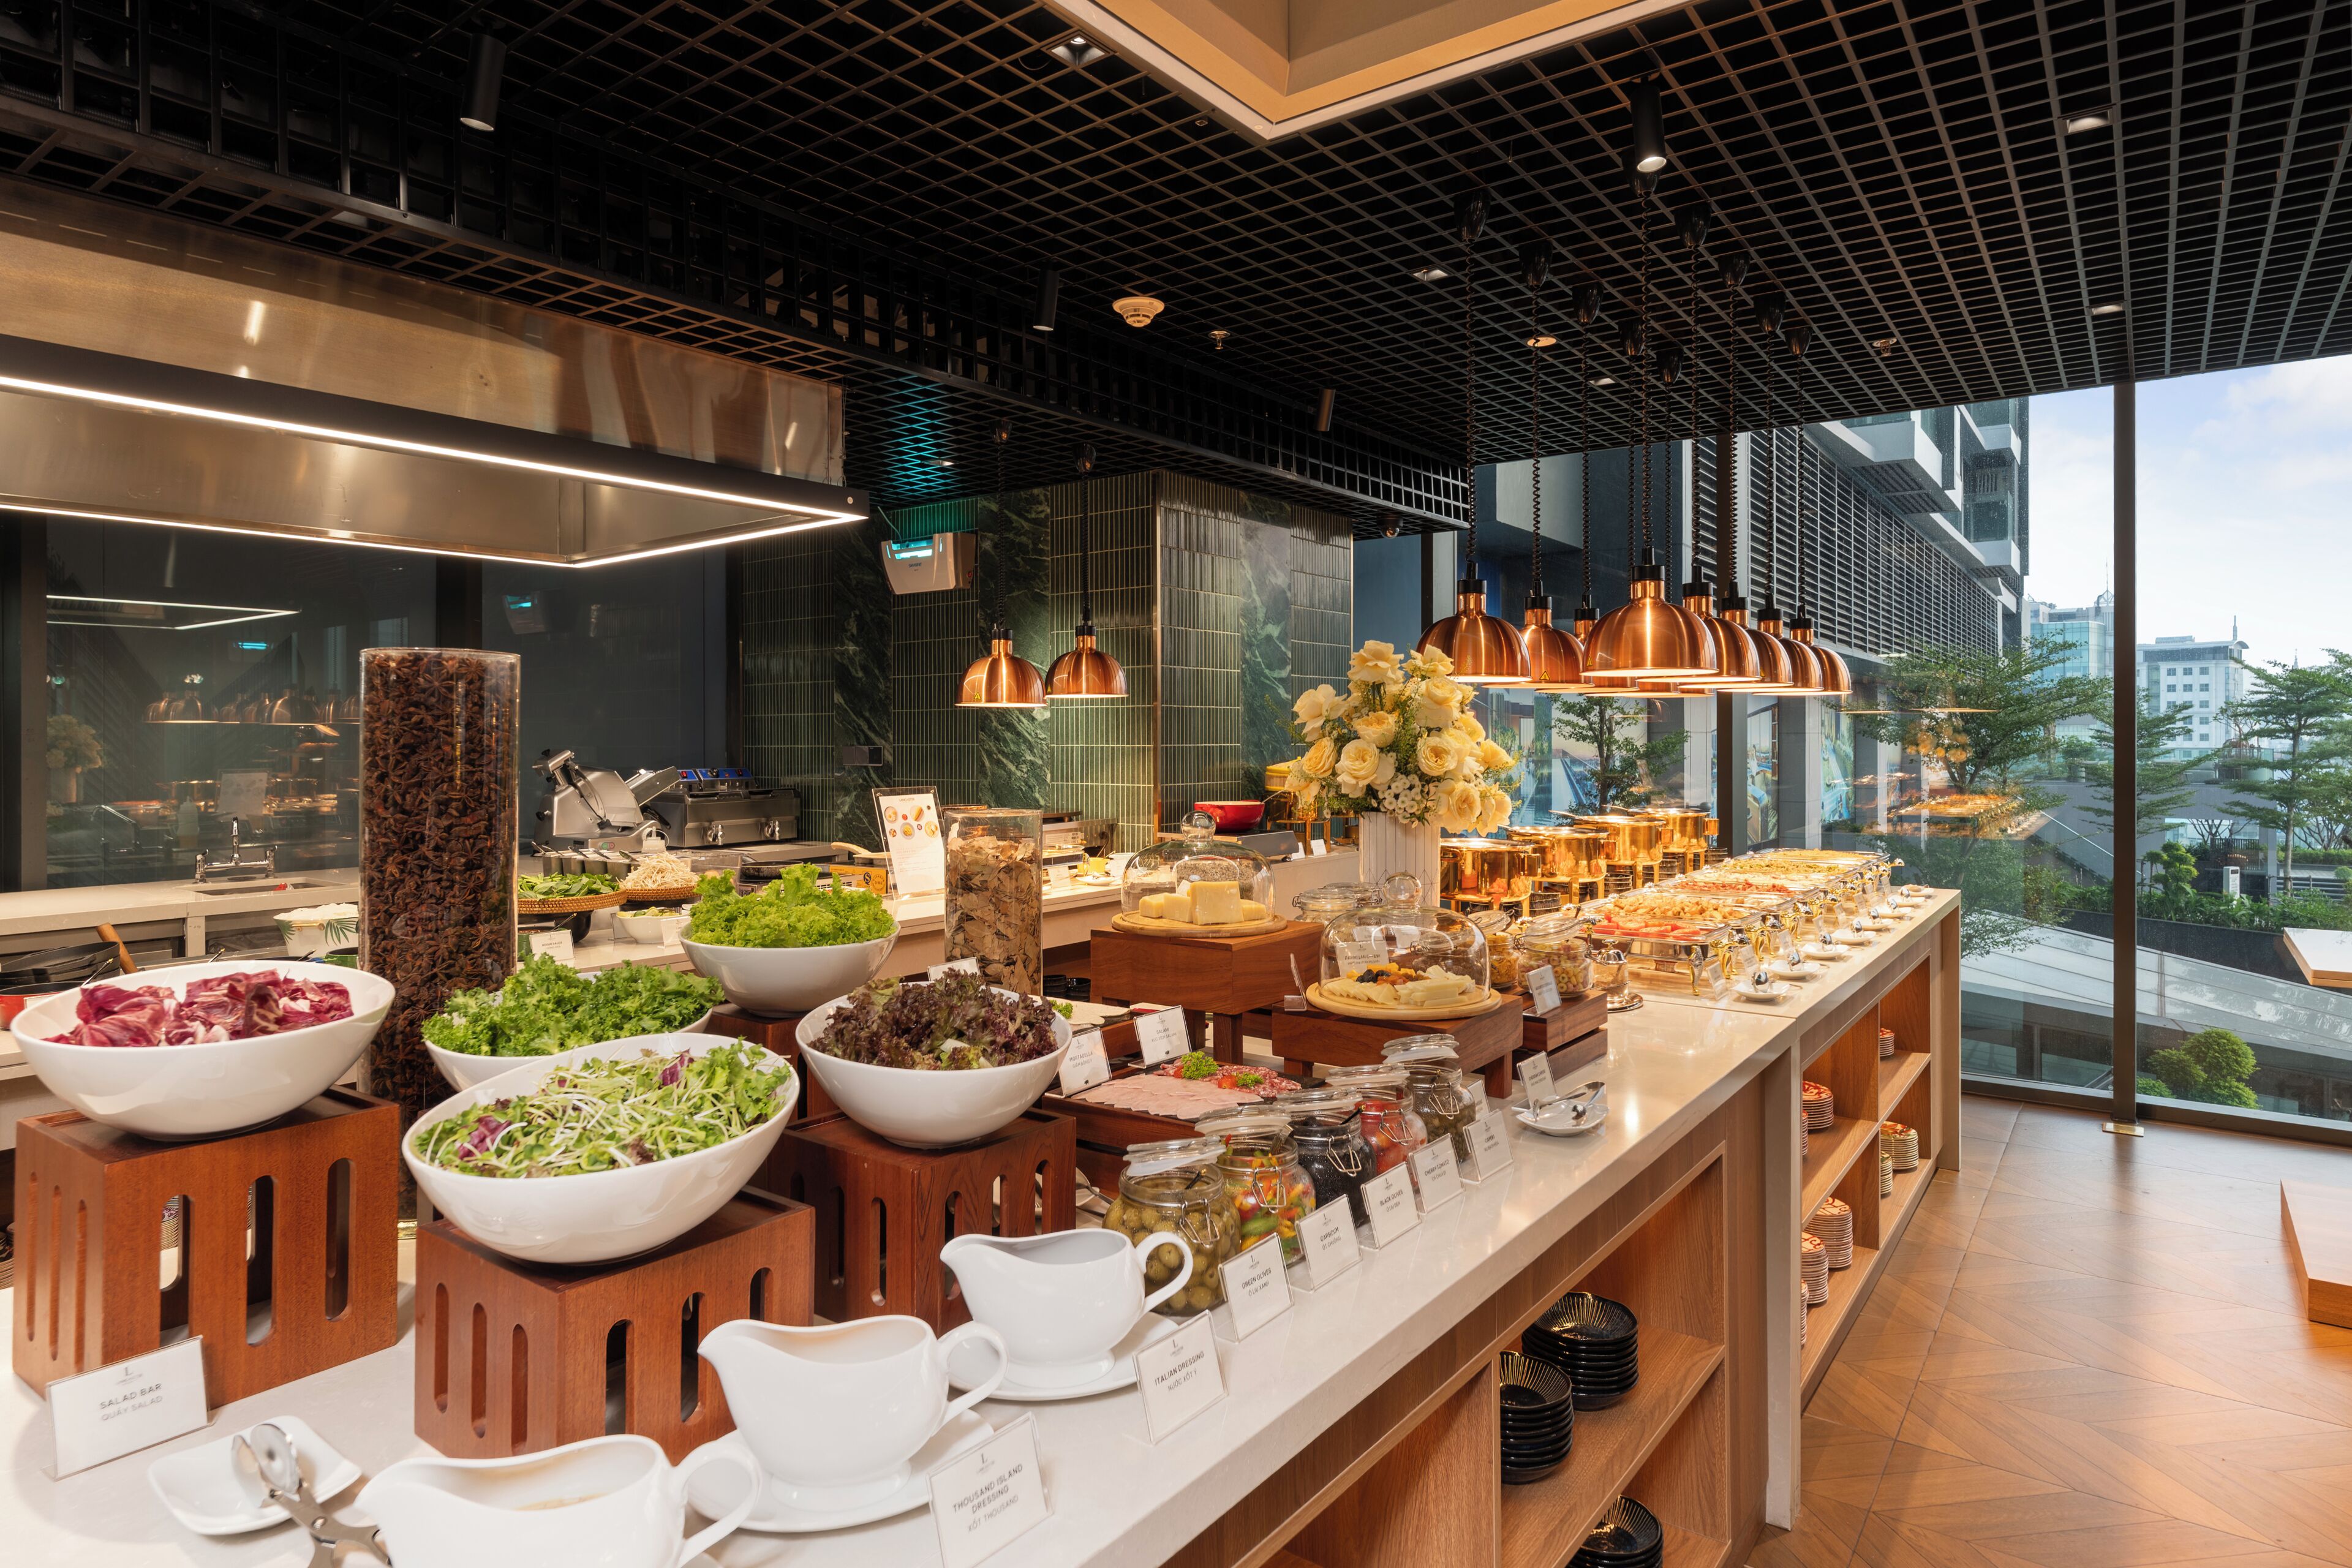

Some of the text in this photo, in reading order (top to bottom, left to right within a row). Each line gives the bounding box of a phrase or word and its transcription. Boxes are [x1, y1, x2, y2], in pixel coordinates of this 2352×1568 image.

[1069, 1050, 1093, 1062] MORTADELLA
[1425, 1159, 1450, 1177] CHERRY TOMATO
[1379, 1188, 1403, 1206] BLACK OLIVES
[1320, 1226, 1340, 1242] CAPSICUM
[1242, 1267, 1272, 1289] GREEN OLIVES
[1154, 1366, 1178, 1387] ITALIAN
[1177, 1350, 1205, 1373] DRESSING
[100, 1382, 162, 1410] SALAD BAR
[130, 1395, 164, 1412] SALAD
[952, 1480, 996, 1513] THOUSAND
[996, 1463, 1023, 1487] ISLAND
[971, 1483, 1009, 1515] DRESSING
[984, 1493, 1020, 1522] THOUSAND
